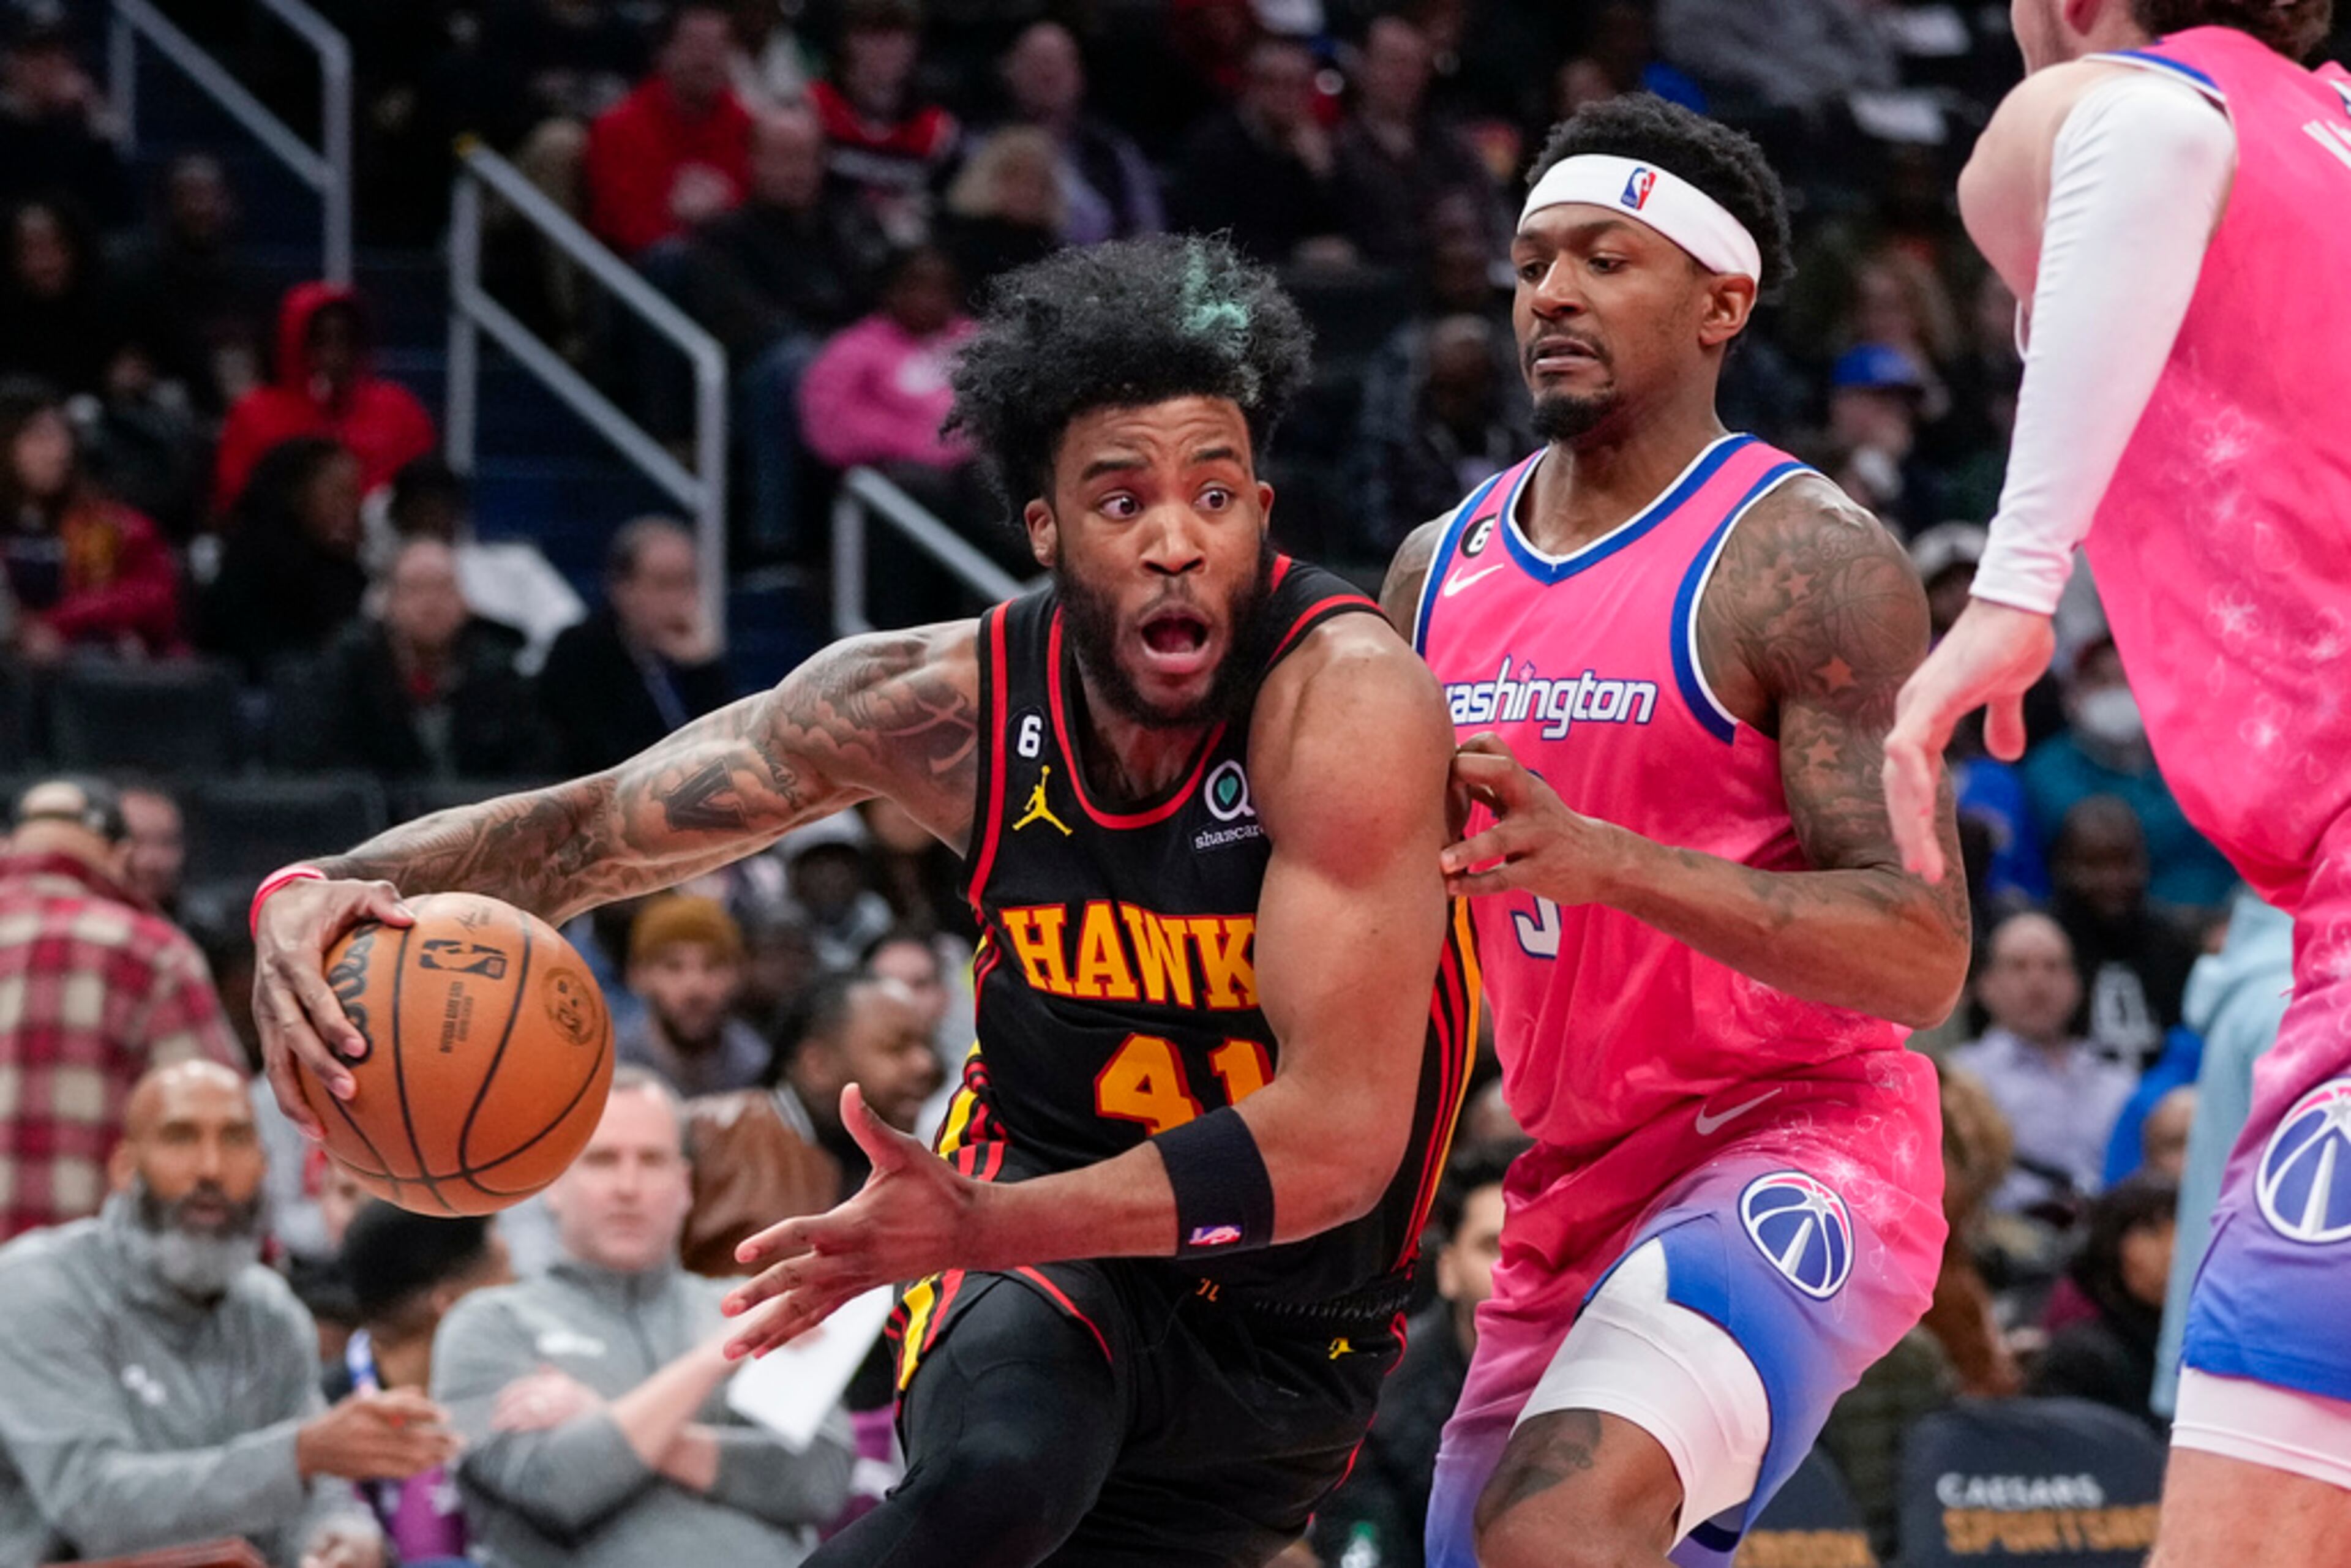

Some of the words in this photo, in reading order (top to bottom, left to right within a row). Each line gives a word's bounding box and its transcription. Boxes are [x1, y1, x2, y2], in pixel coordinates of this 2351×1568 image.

[1468, 519, 1496, 553] 6
[1445, 653, 1658, 741] ashington
[1017, 714, 1042, 758] 6
[999, 899, 1260, 1012] HAWK
[1093, 1032, 1275, 1137] 41
[1935, 1471, 2106, 1509] CAESARS
